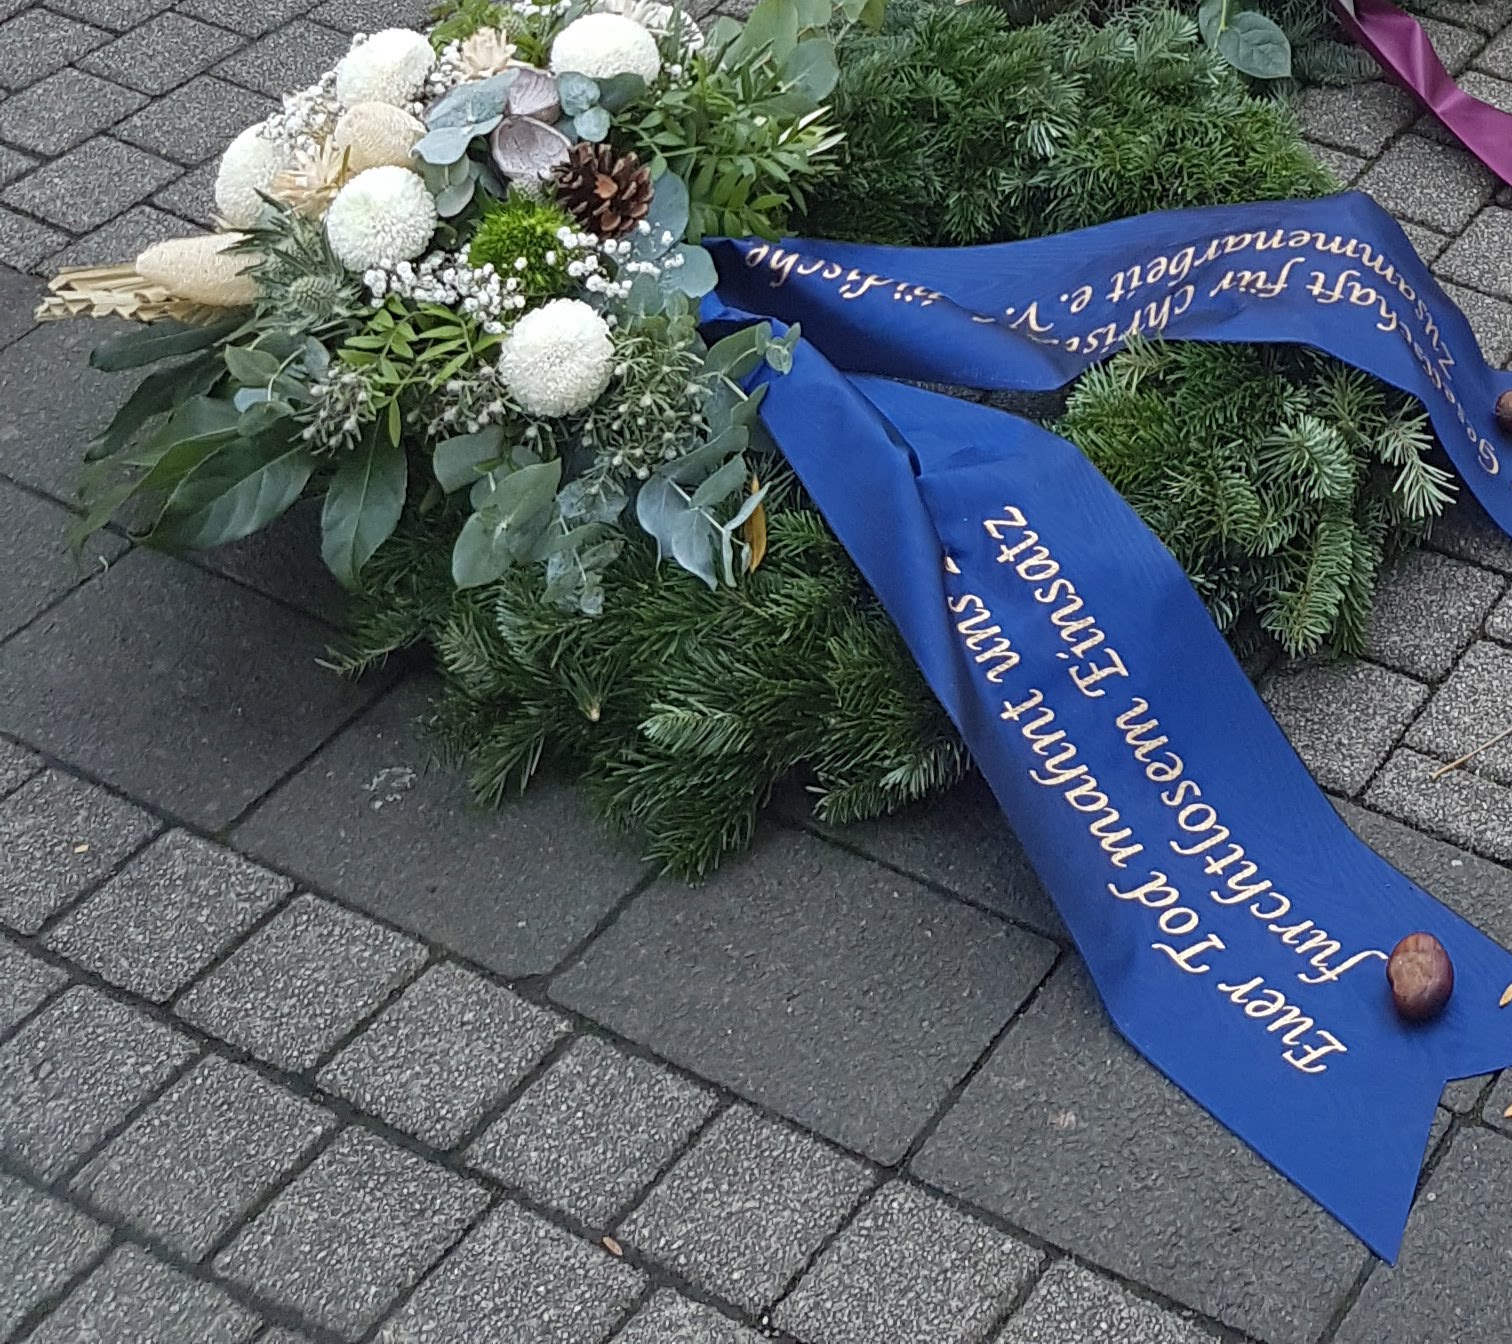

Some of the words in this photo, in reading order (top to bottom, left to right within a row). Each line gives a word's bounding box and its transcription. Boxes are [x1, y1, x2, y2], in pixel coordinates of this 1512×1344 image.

[746, 241, 944, 302] üdische
[1004, 300, 1056, 333] V.
[1060, 284, 1094, 314] e.
[1104, 227, 1456, 382] Zusammenarbeit
[1208, 256, 1307, 299] für
[947, 591, 1021, 684] uns
[982, 505, 1132, 699] Einsatz
[1000, 688, 1147, 869] mahnt
[1113, 696, 1389, 985] furchtlosem
[1107, 870, 1228, 975] Tod
[1219, 976, 1349, 1074] Euer
